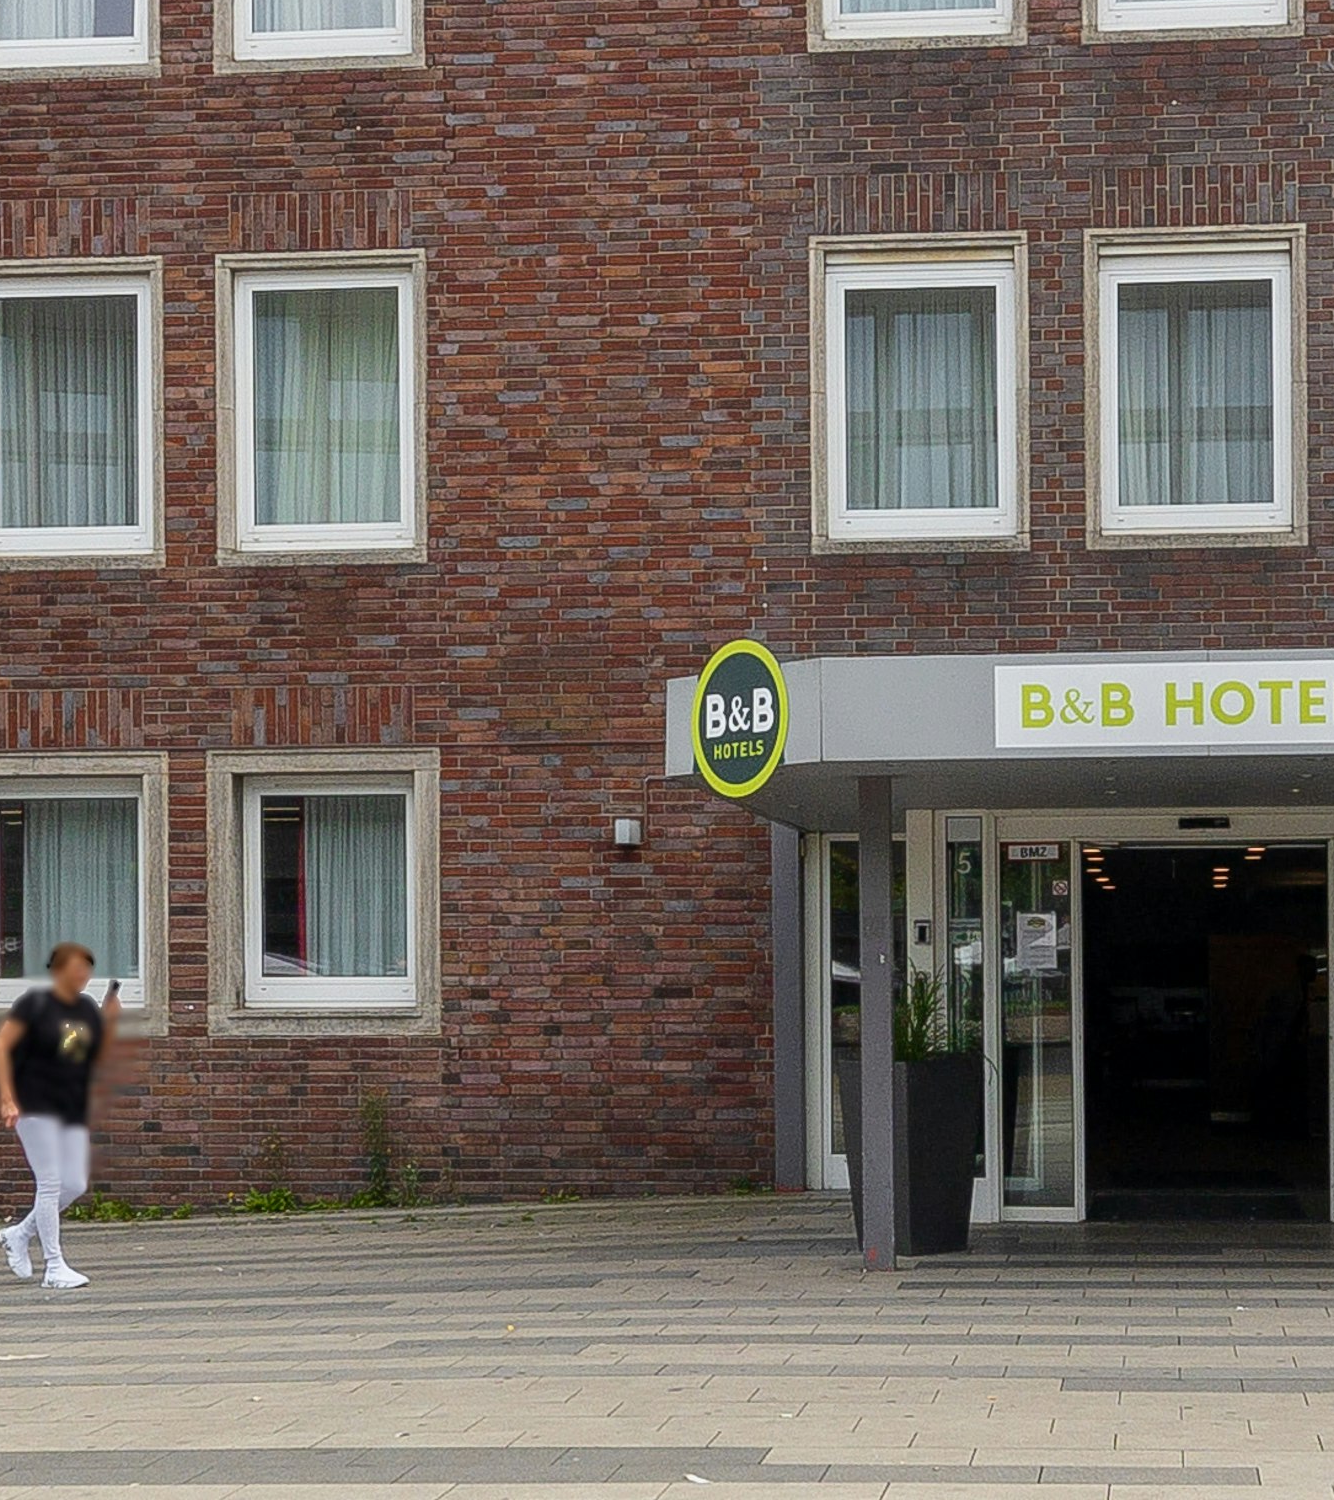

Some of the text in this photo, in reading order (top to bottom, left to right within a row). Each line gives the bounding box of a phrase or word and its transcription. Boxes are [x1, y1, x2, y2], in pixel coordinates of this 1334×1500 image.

[706, 687, 774, 739] B&B
[1021, 682, 1135, 728] B&B
[713, 740, 764, 760] HOTELS
[955, 851, 972, 875] 5
[1020, 846, 1047, 858] BMZ
